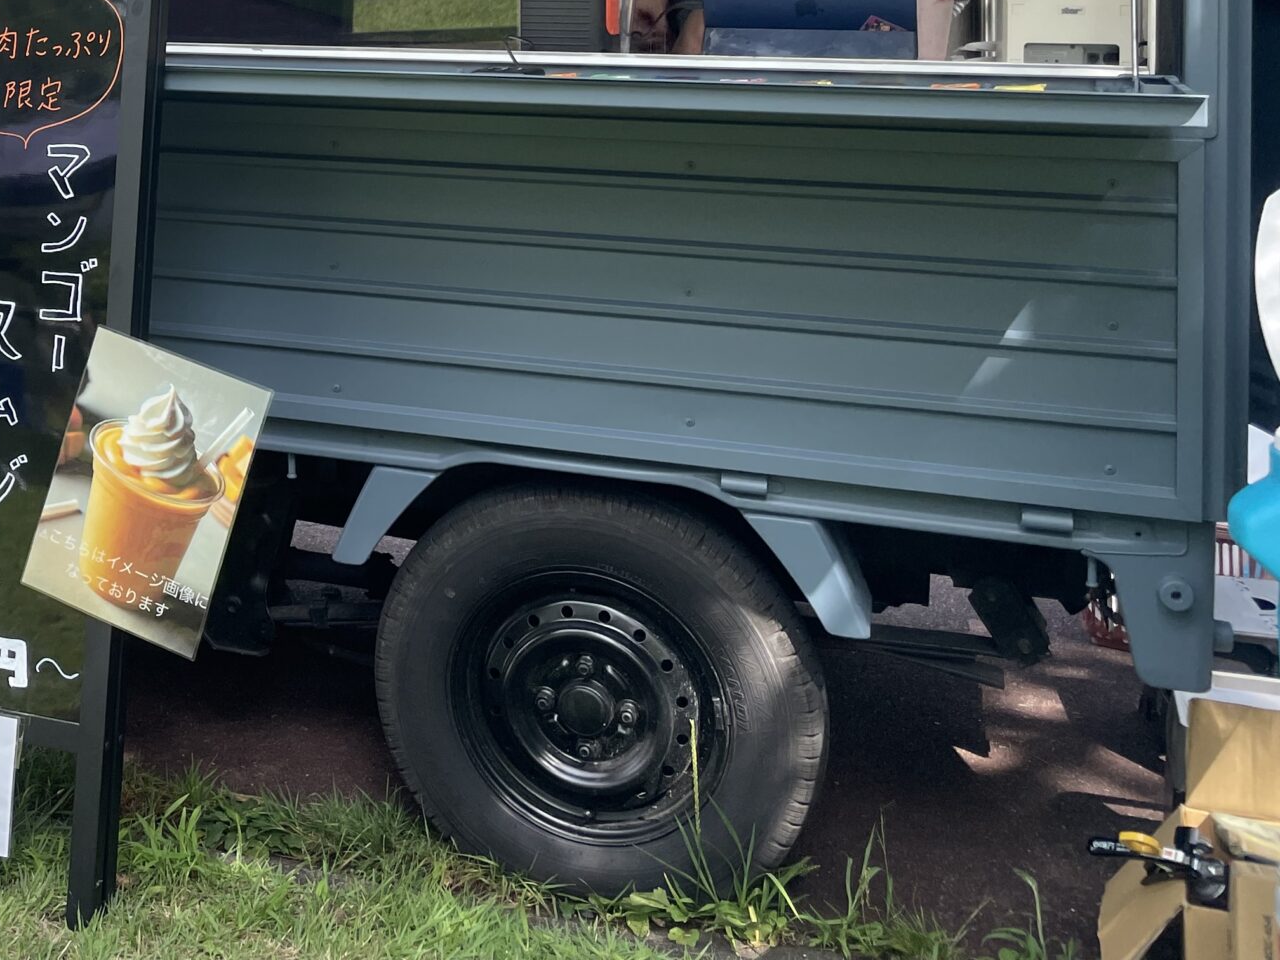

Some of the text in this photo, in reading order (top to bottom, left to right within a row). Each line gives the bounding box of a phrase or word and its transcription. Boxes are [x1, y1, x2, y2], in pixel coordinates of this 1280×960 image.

[39, 144, 98, 372] マンゴー
[65, 561, 170, 617] なっております
